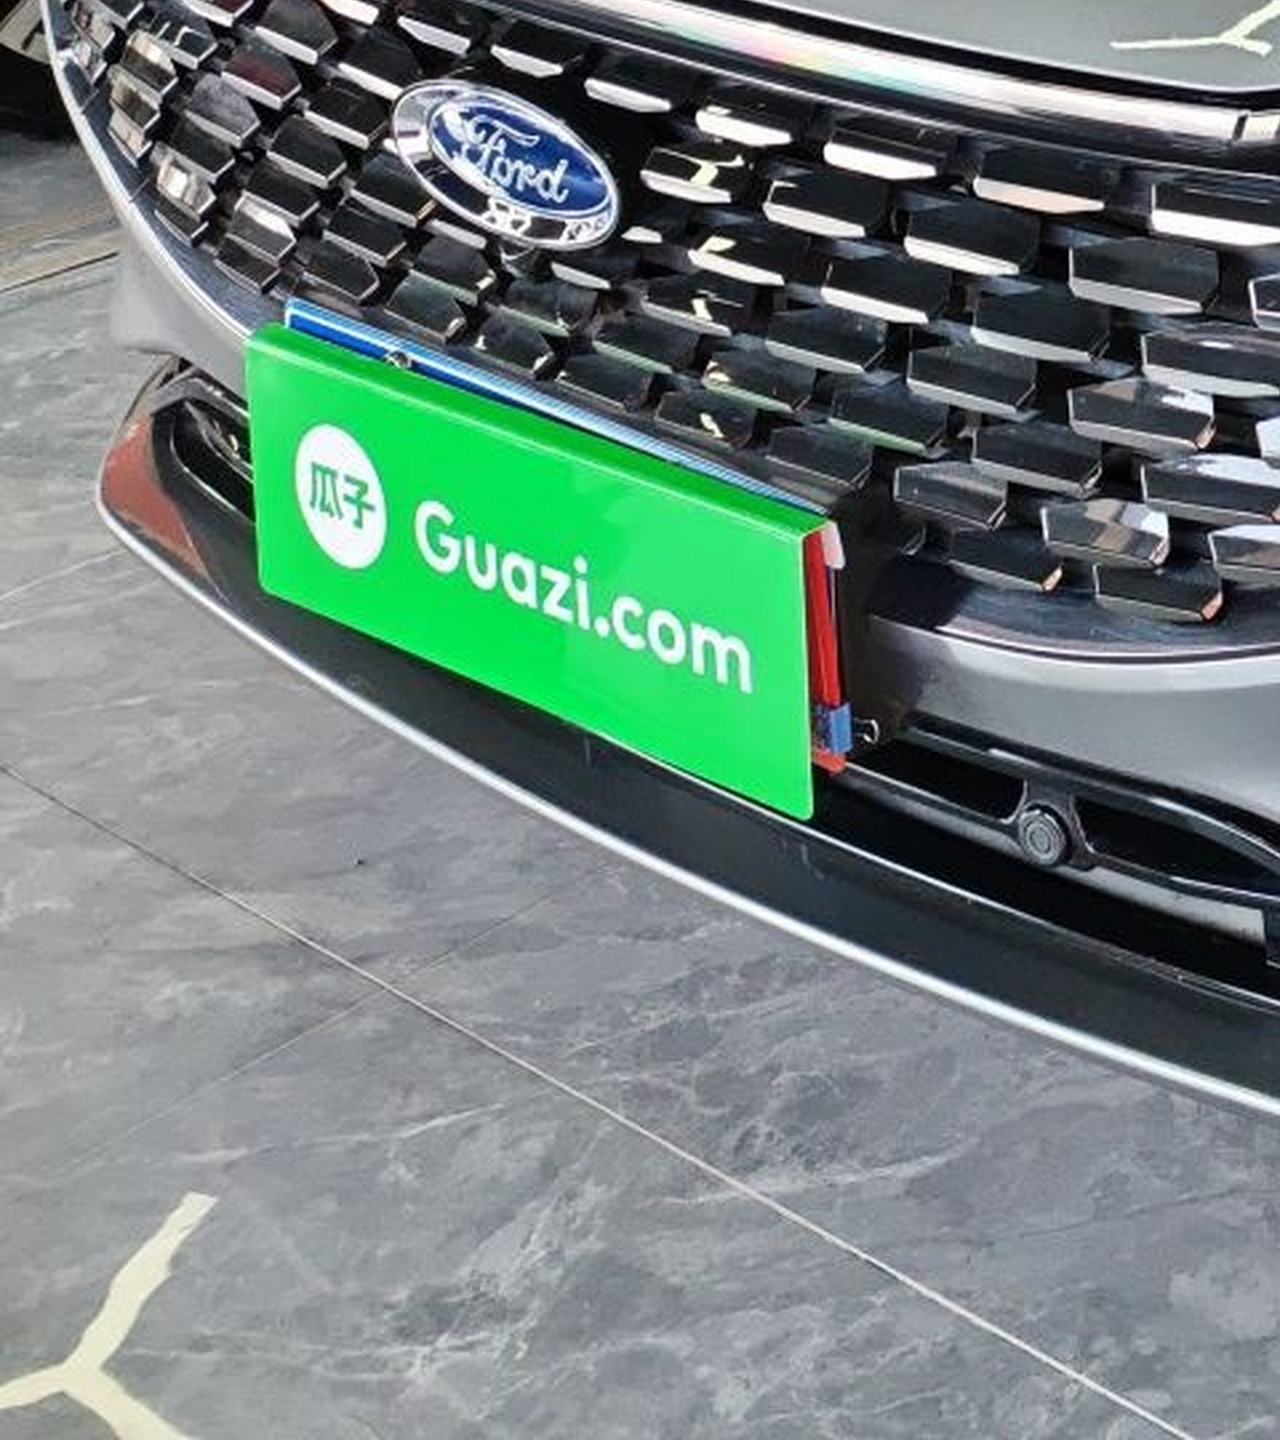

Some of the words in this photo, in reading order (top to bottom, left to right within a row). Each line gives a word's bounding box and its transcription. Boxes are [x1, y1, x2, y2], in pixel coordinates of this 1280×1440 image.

[453, 115, 569, 204] Ford
[307, 461, 377, 530] 瓜子
[414, 500, 754, 694] Guazi.com
